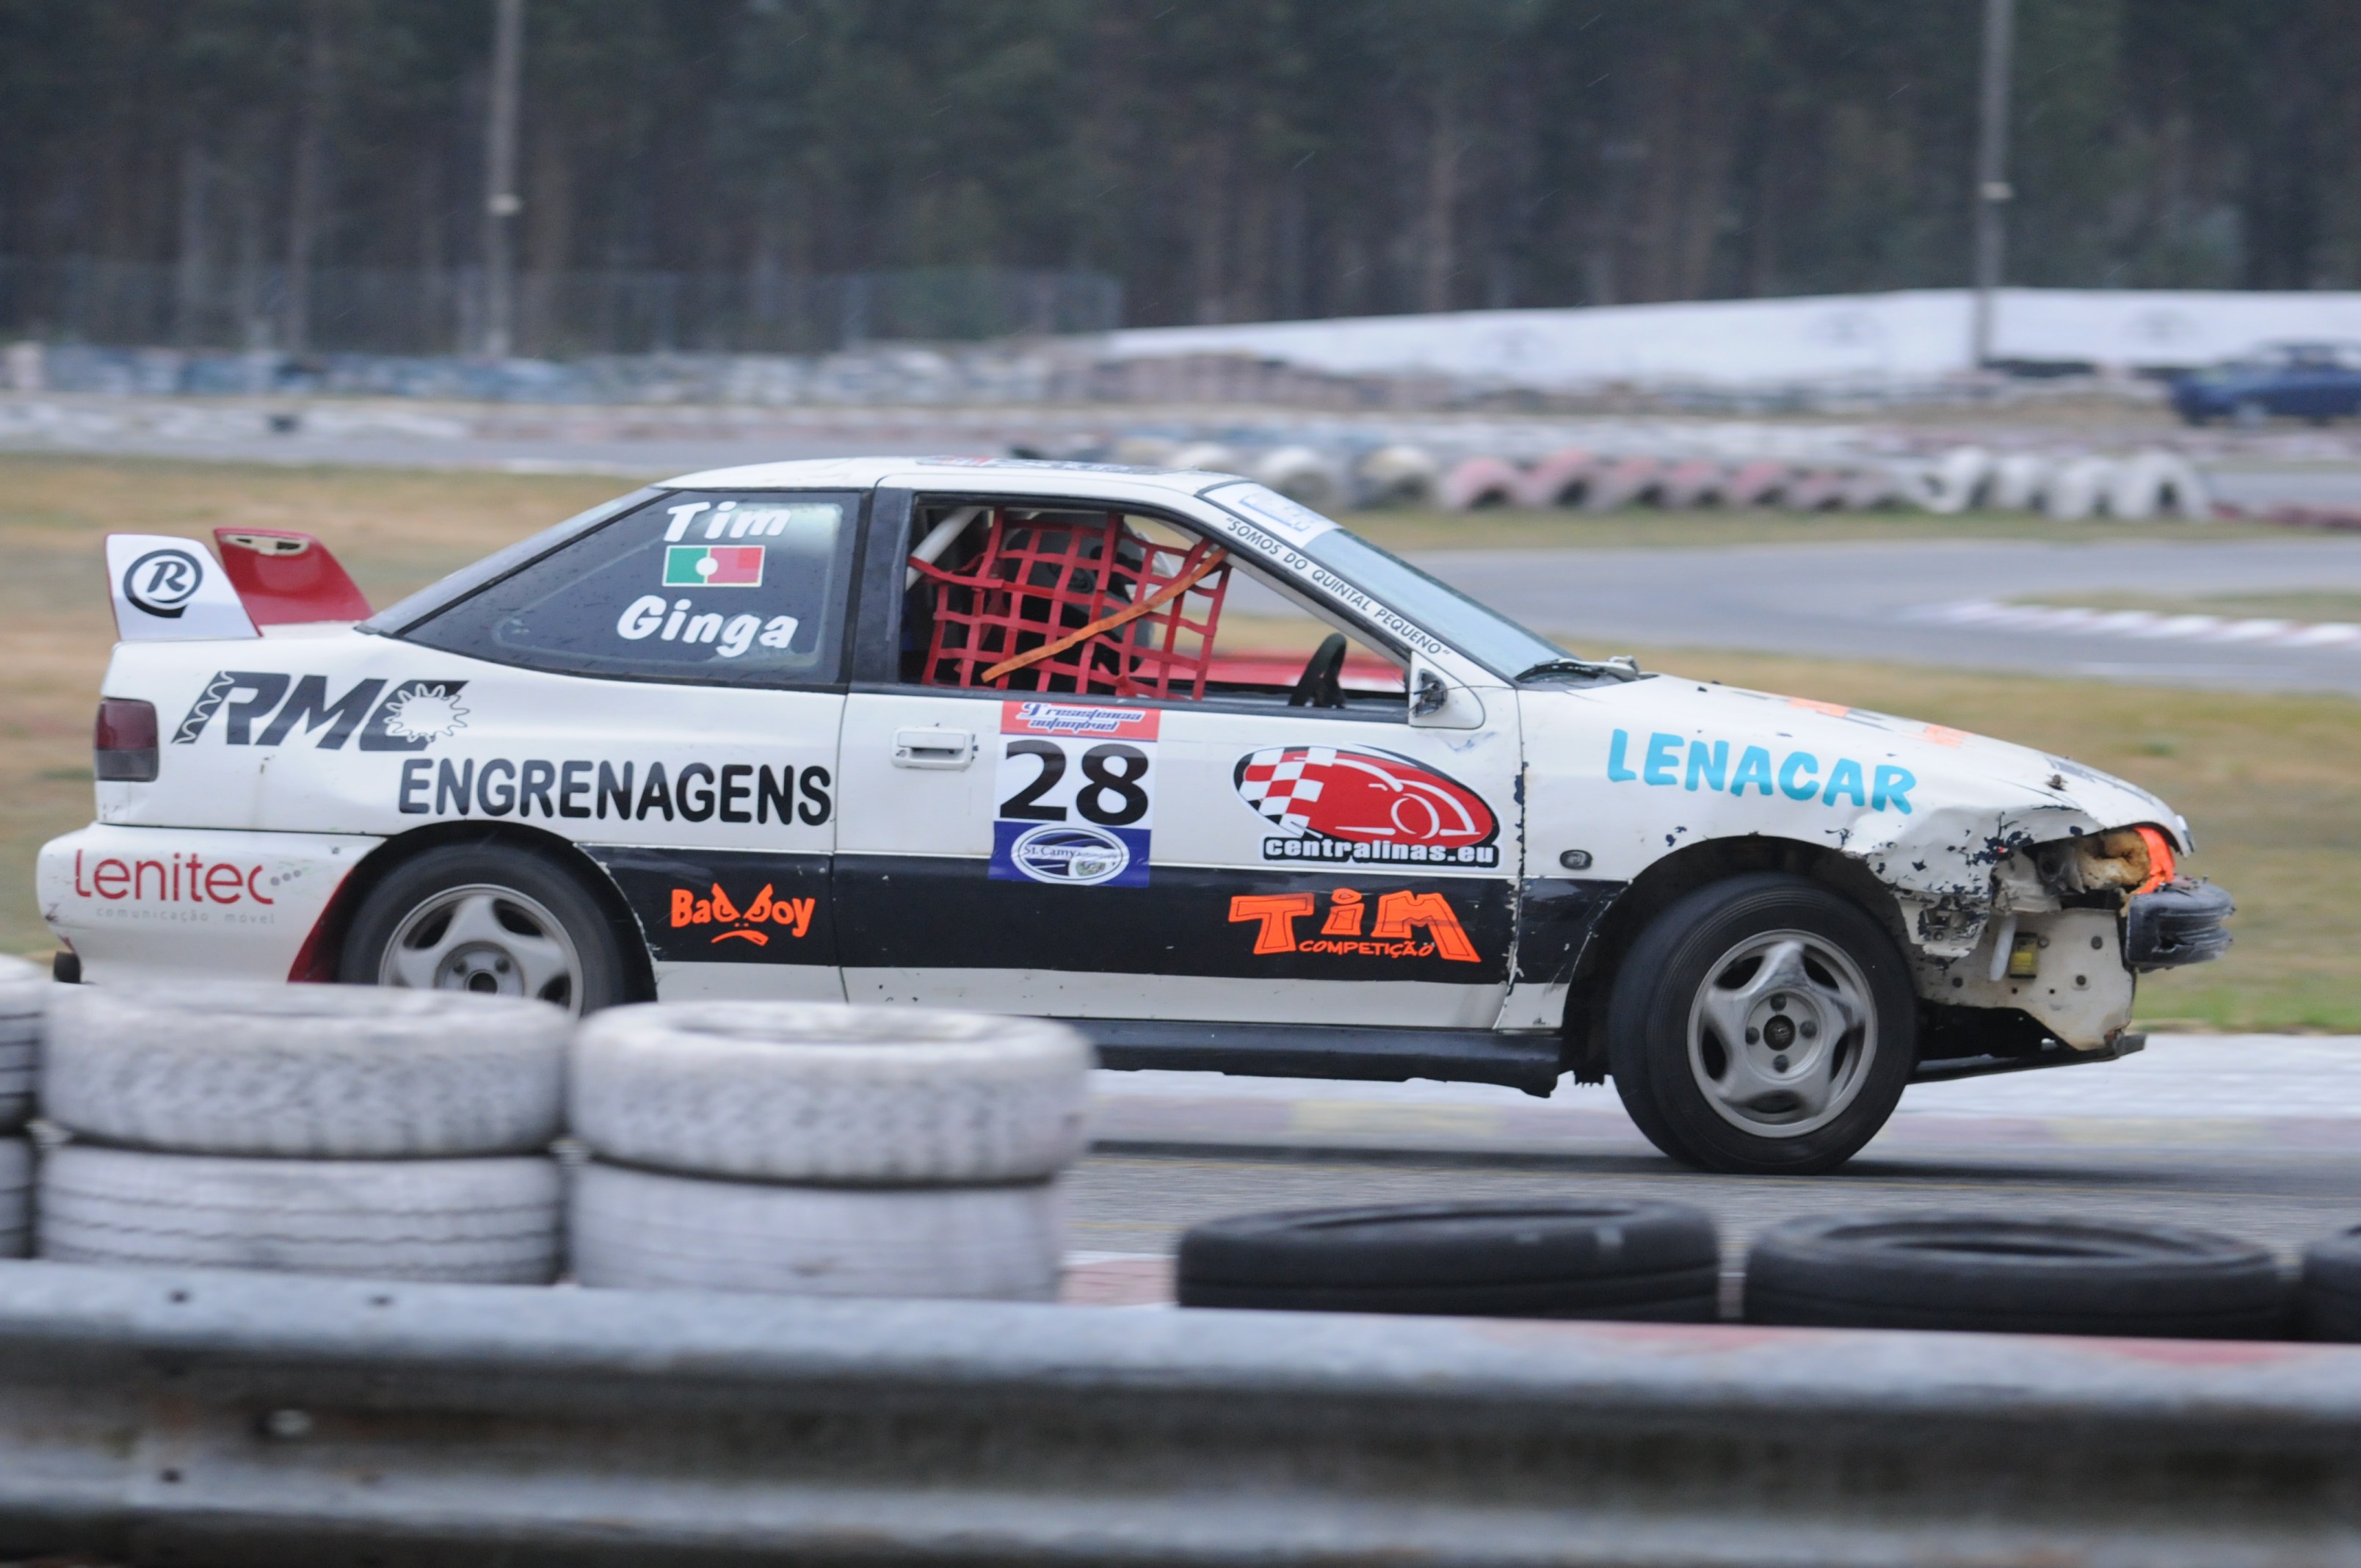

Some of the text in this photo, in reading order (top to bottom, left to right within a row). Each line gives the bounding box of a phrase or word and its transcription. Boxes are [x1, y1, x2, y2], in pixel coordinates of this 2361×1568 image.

[664, 501, 791, 542] Tim
[1284, 552, 1308, 570] DO
[1312, 569, 1370, 611] QUINTAL
[616, 595, 799, 658] Ginga
[170, 671, 470, 752] RMC
[398, 758, 832, 826] ENGRENAGENS
[999, 739, 1149, 826] 28
[1607, 729, 1916, 814] LENACAR
[1265, 838, 1494, 863] centralinas.eu
[95, 907, 209, 923] comunicação
[671, 882, 741, 928] Bad
[1299, 940, 1437, 958] COMPETIÇÃO
